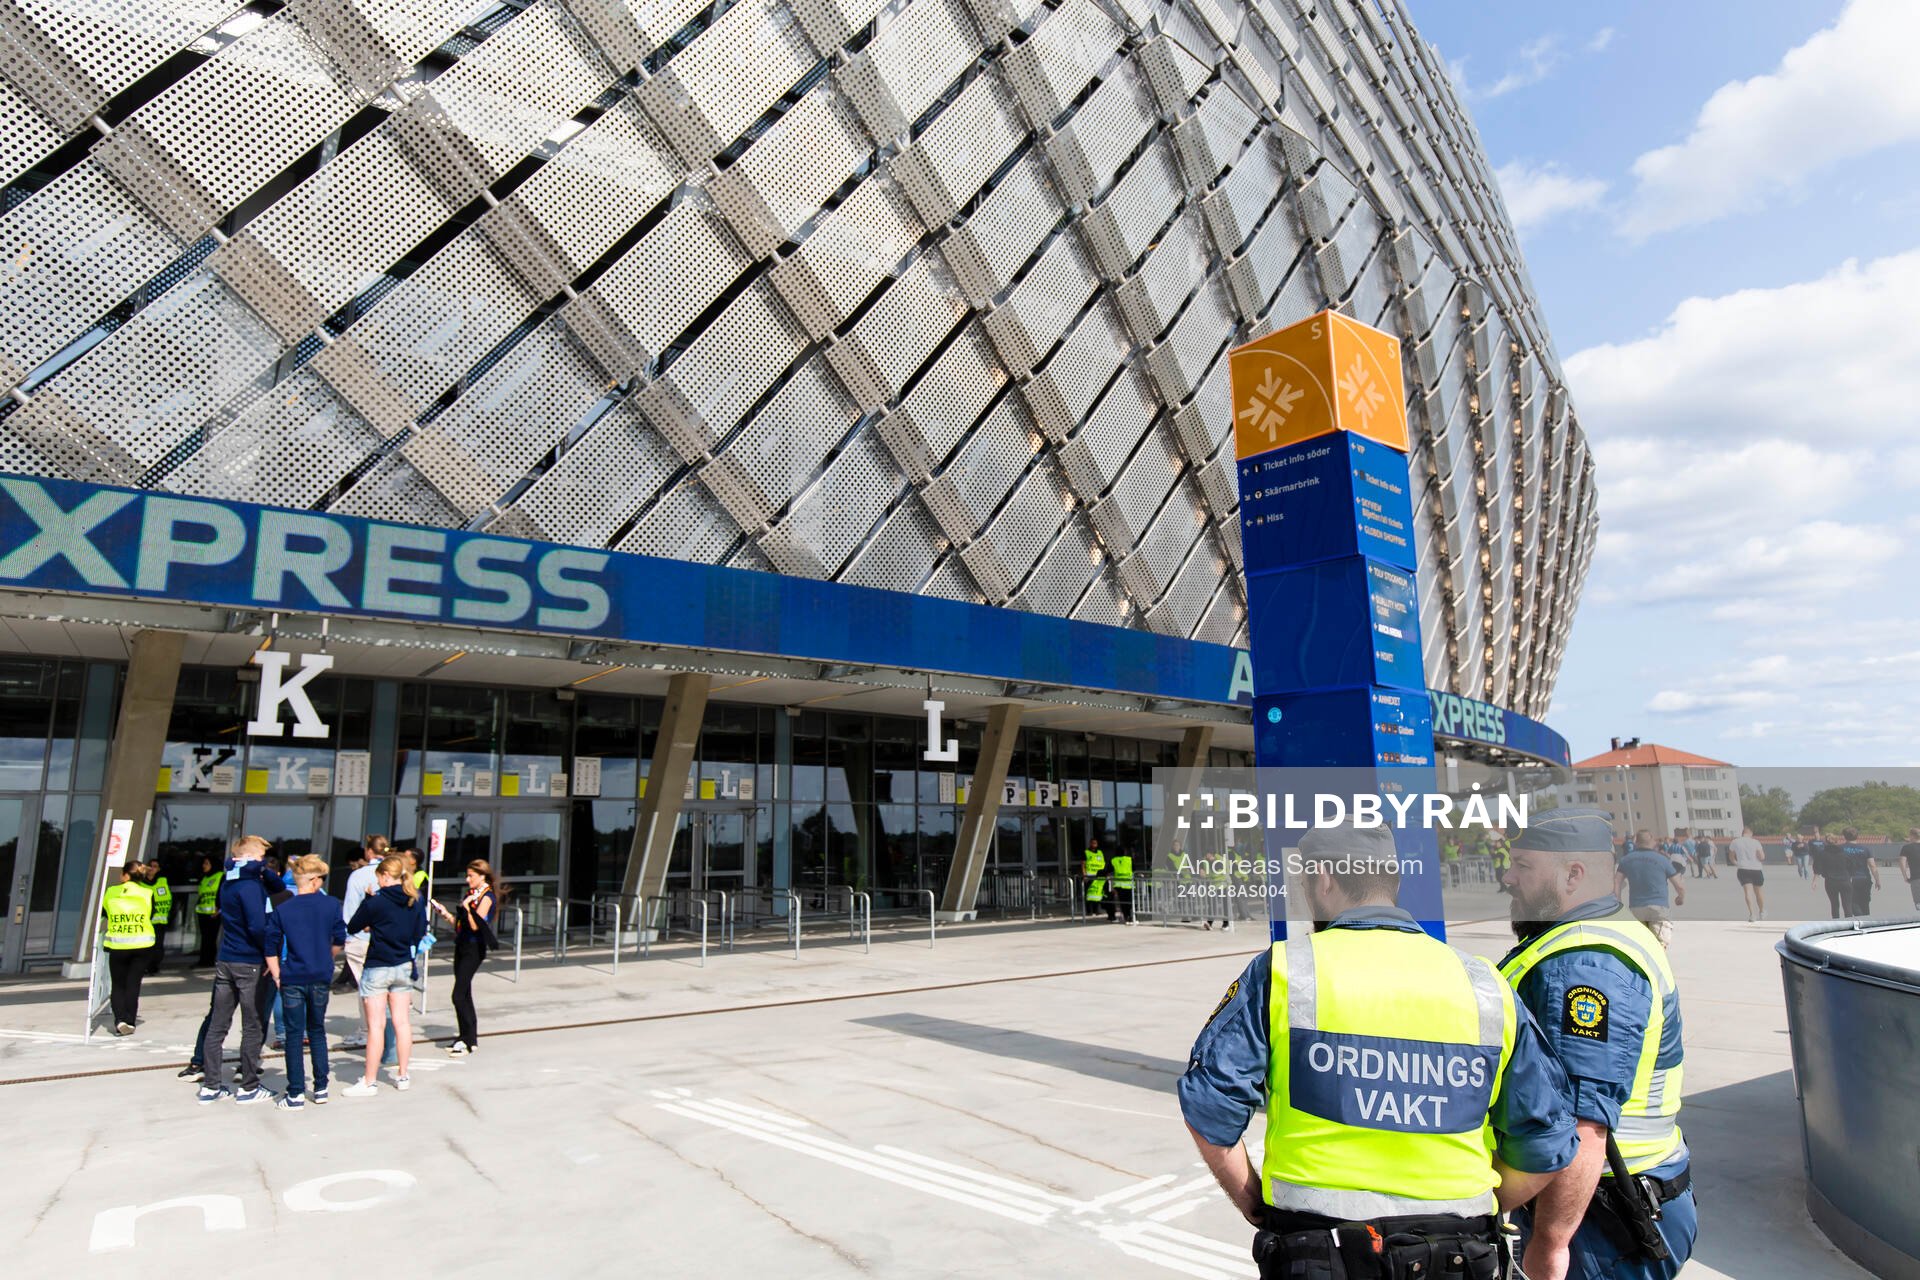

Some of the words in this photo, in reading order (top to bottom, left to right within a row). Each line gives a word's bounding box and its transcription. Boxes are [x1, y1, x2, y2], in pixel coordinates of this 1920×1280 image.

[1311, 322, 1322, 339] S
[1387, 342, 1395, 359] S
[1263, 458, 1287, 471] Ticket
[1306, 447, 1331, 460] söder
[1265, 477, 1319, 497] Skärmarbrink
[1266, 512, 1284, 523] Hiss
[247, 650, 334, 739] K
[1425, 688, 1506, 745] XPRESS
[923, 701, 958, 761] L
[178, 753, 212, 789] K
[275, 756, 308, 790] K
[452, 762, 472, 792] L
[527, 764, 546, 793] L
[720, 769, 737, 797] L
[110, 914, 145, 923] SERVICE
[111, 924, 144, 933] SAFETY
[1567, 987, 1607, 1006] ORDNINGS
[1571, 1027, 1600, 1038] VAKT
[1308, 1042, 1486, 1088] ORDNINGS
[1354, 1087, 1448, 1128] VAKT
